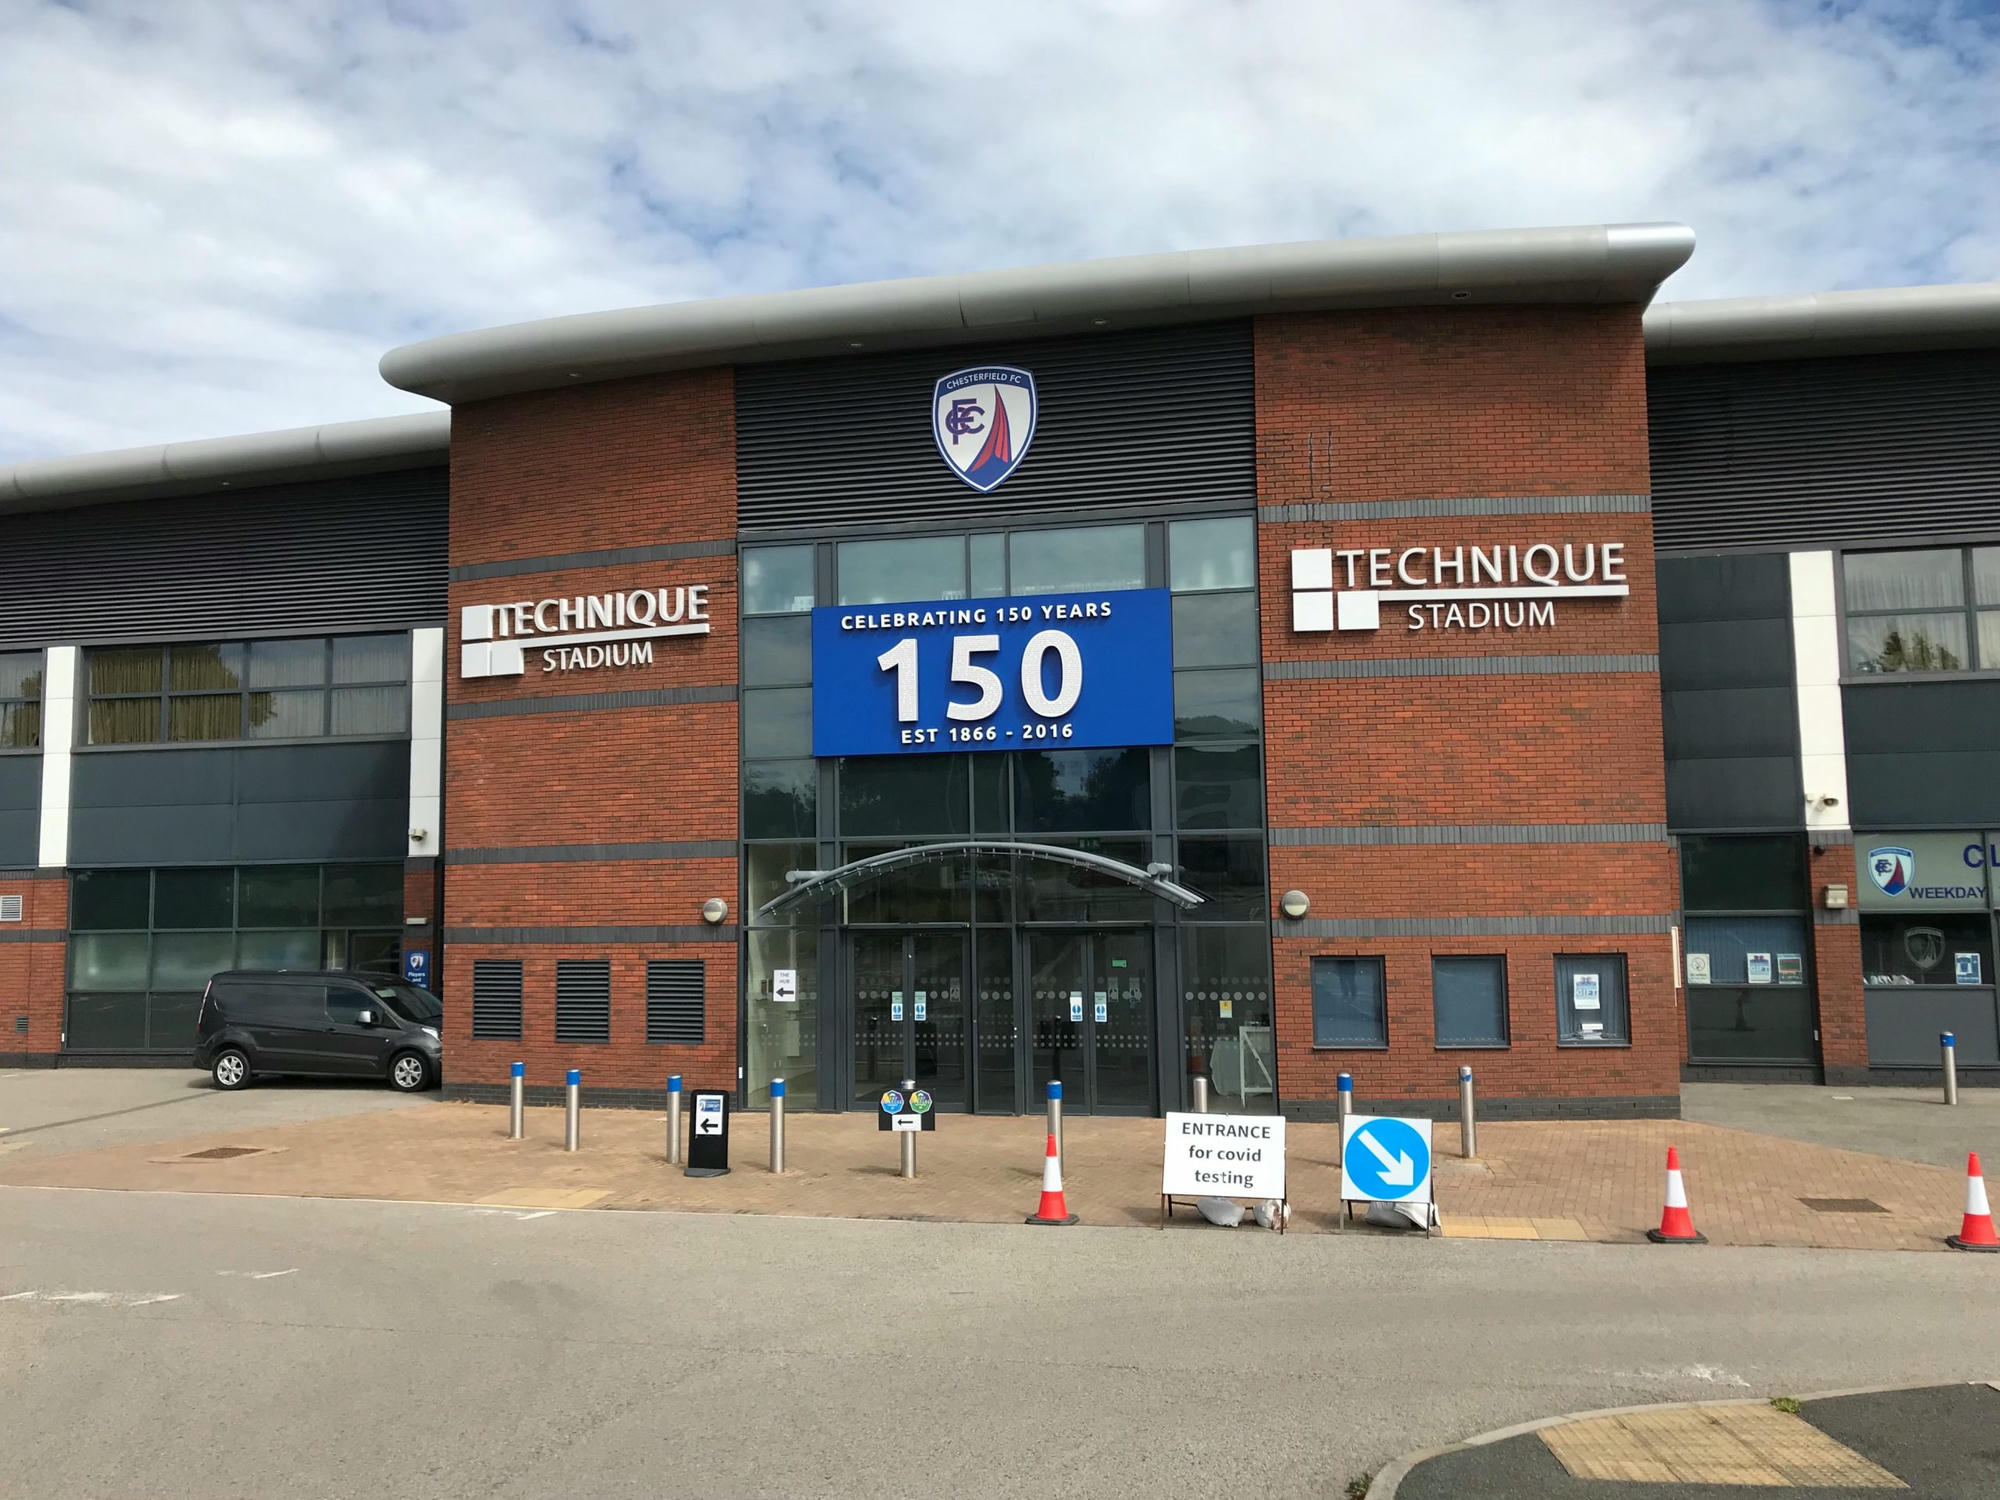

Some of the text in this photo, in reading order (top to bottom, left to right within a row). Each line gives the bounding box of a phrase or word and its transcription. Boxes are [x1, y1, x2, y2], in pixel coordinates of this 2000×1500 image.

[946, 372, 1022, 389] CHESTERFIELD FC
[1336, 543, 1627, 588] TECHNIQUE
[492, 585, 710, 637] TECHNIQUE
[841, 602, 1112, 630] CELEBRATING 150 YEARS
[1408, 601, 1556, 630] STADIUM
[542, 641, 653, 672] STADIUM
[877, 629, 1083, 722] 150
[901, 728, 938, 744] EST
[949, 725, 997, 742] 1866
[1022, 723, 1073, 740] 2016
[1909, 887, 1988, 899] WEEKDAY
[1182, 1122, 1271, 1139] ENTRANCE
[1189, 1145, 1262, 1162] for covid
[1195, 1169, 1254, 1189] testing
